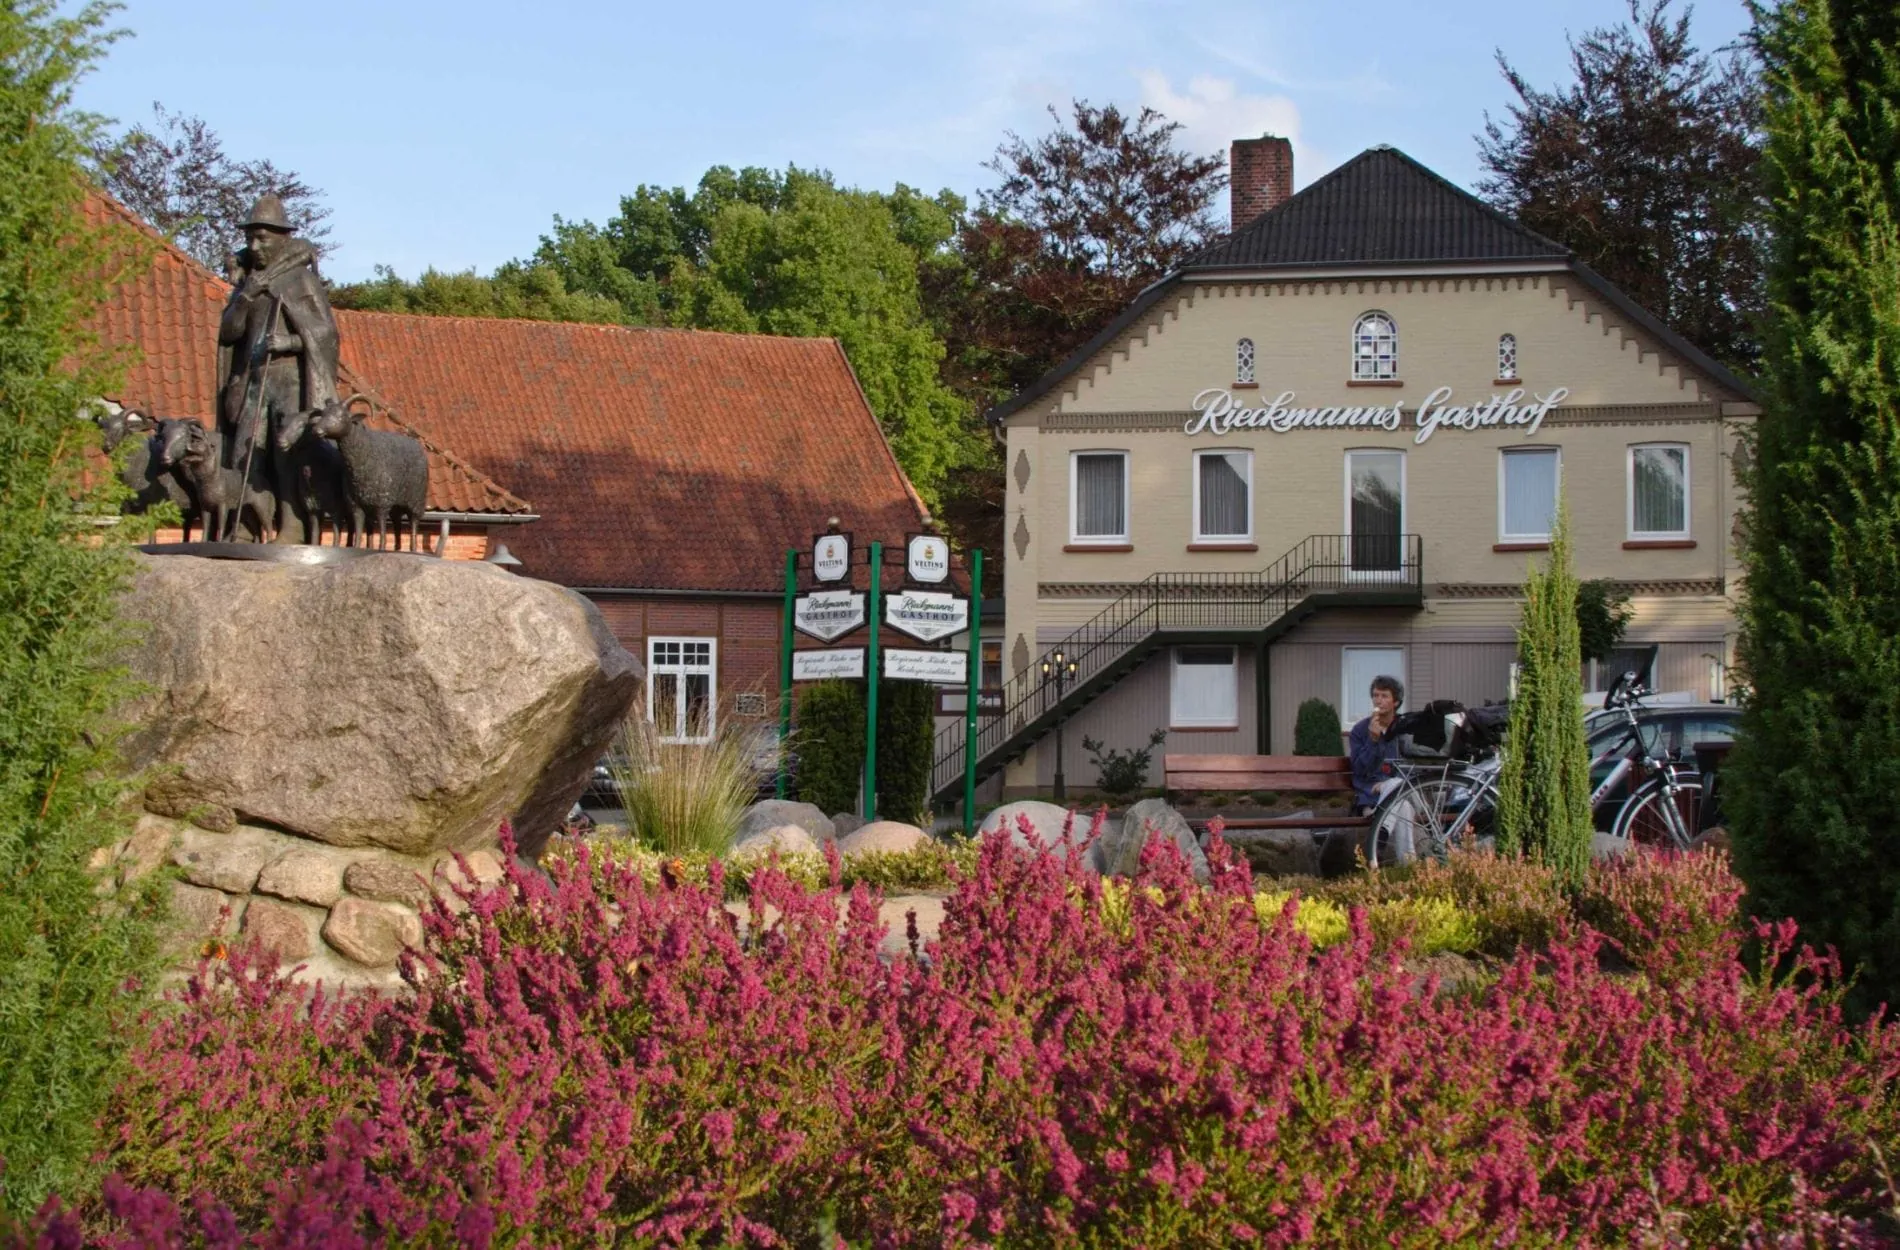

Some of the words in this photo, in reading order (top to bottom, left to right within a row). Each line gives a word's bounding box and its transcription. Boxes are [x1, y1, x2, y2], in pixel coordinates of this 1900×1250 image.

[1184, 389, 1405, 436] Rieckmanns
[1413, 386, 1569, 444] Gasthof
[818, 560, 843, 568] VELTINS
[914, 560, 944, 569] VELTINS
[901, 596, 955, 612] Rieckmanns
[806, 610, 853, 620] GASTHOF
[900, 611, 956, 621] GASTHOF
